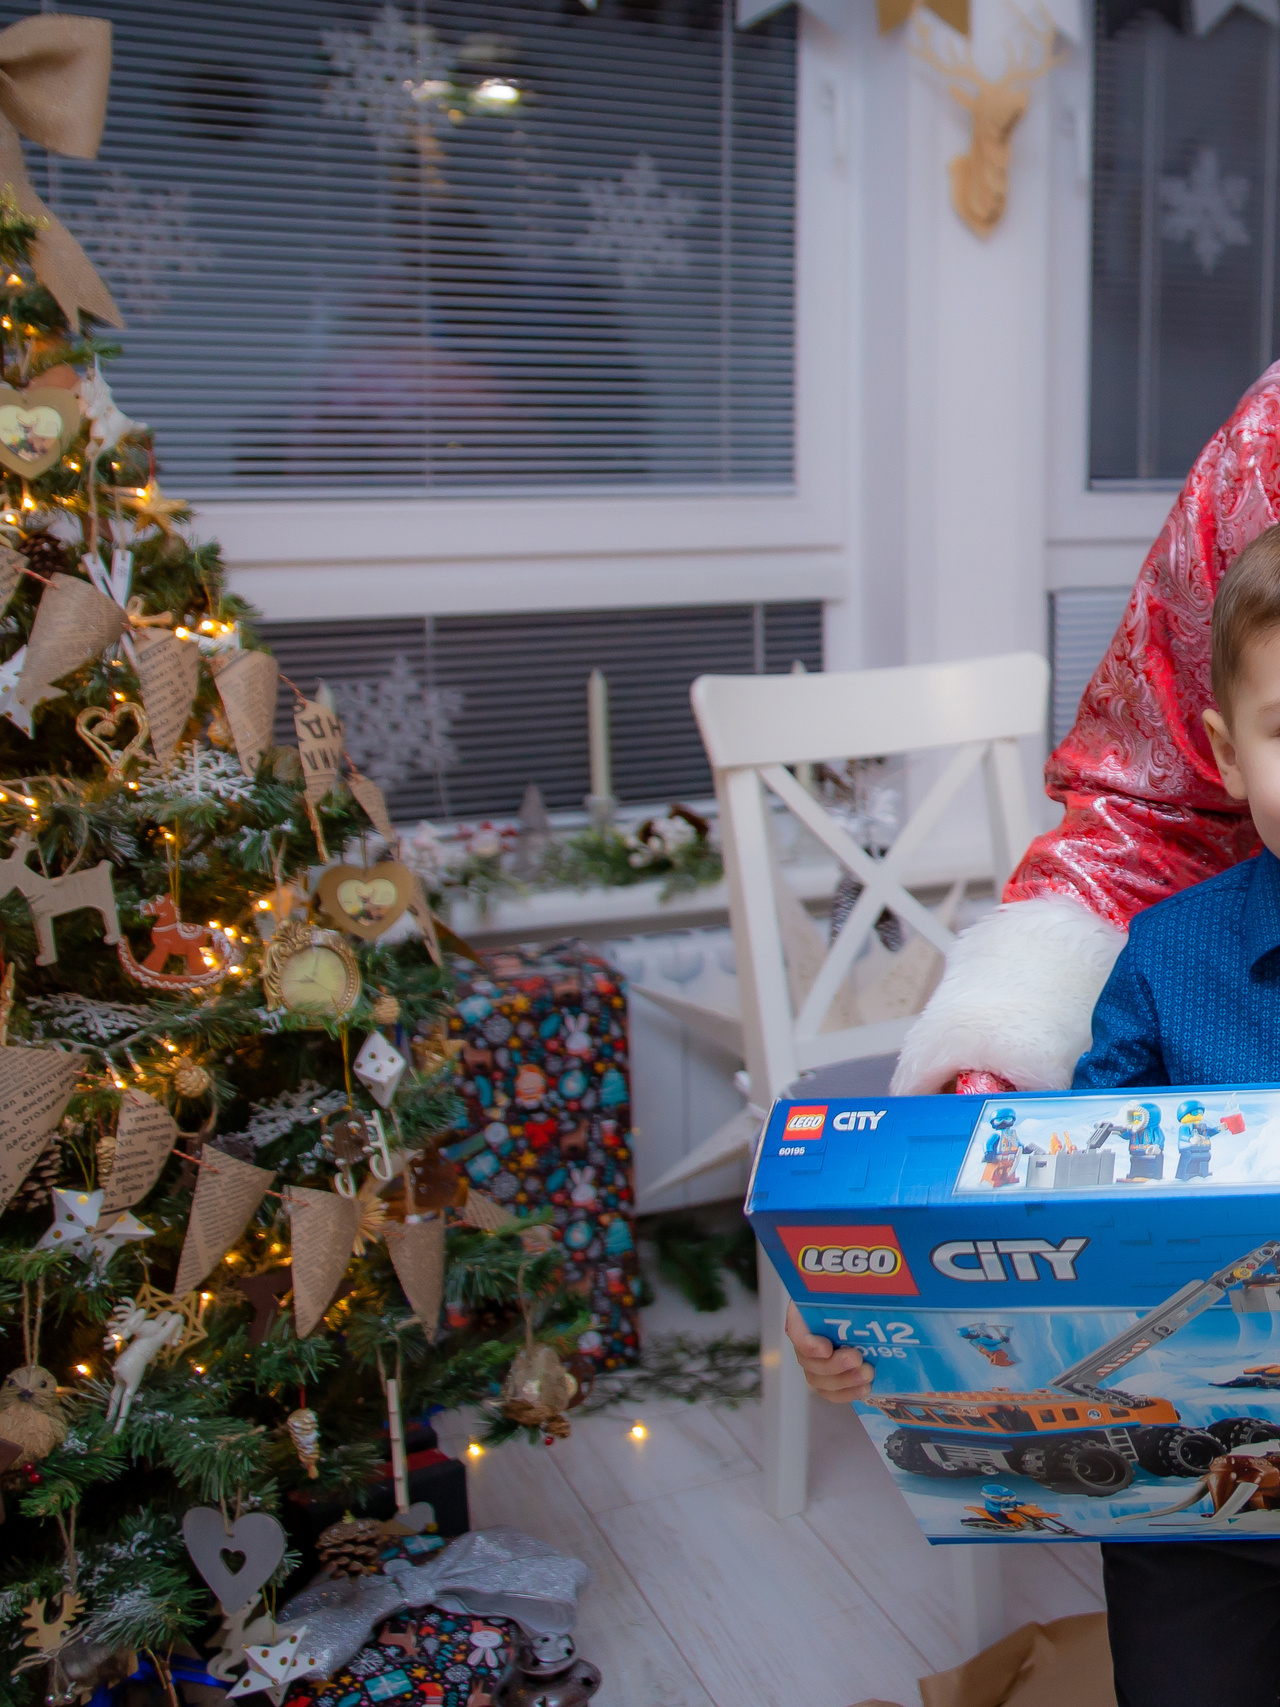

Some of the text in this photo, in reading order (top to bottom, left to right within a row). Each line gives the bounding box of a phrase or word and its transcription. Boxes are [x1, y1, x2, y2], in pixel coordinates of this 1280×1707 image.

[789, 1110, 888, 1131] LEGO CITY
[779, 1146, 806, 1156] 60195
[803, 1237, 1091, 1282] LEGO CITY
[823, 1318, 920, 1345] 7-12
[841, 1344, 908, 1359] 0195
